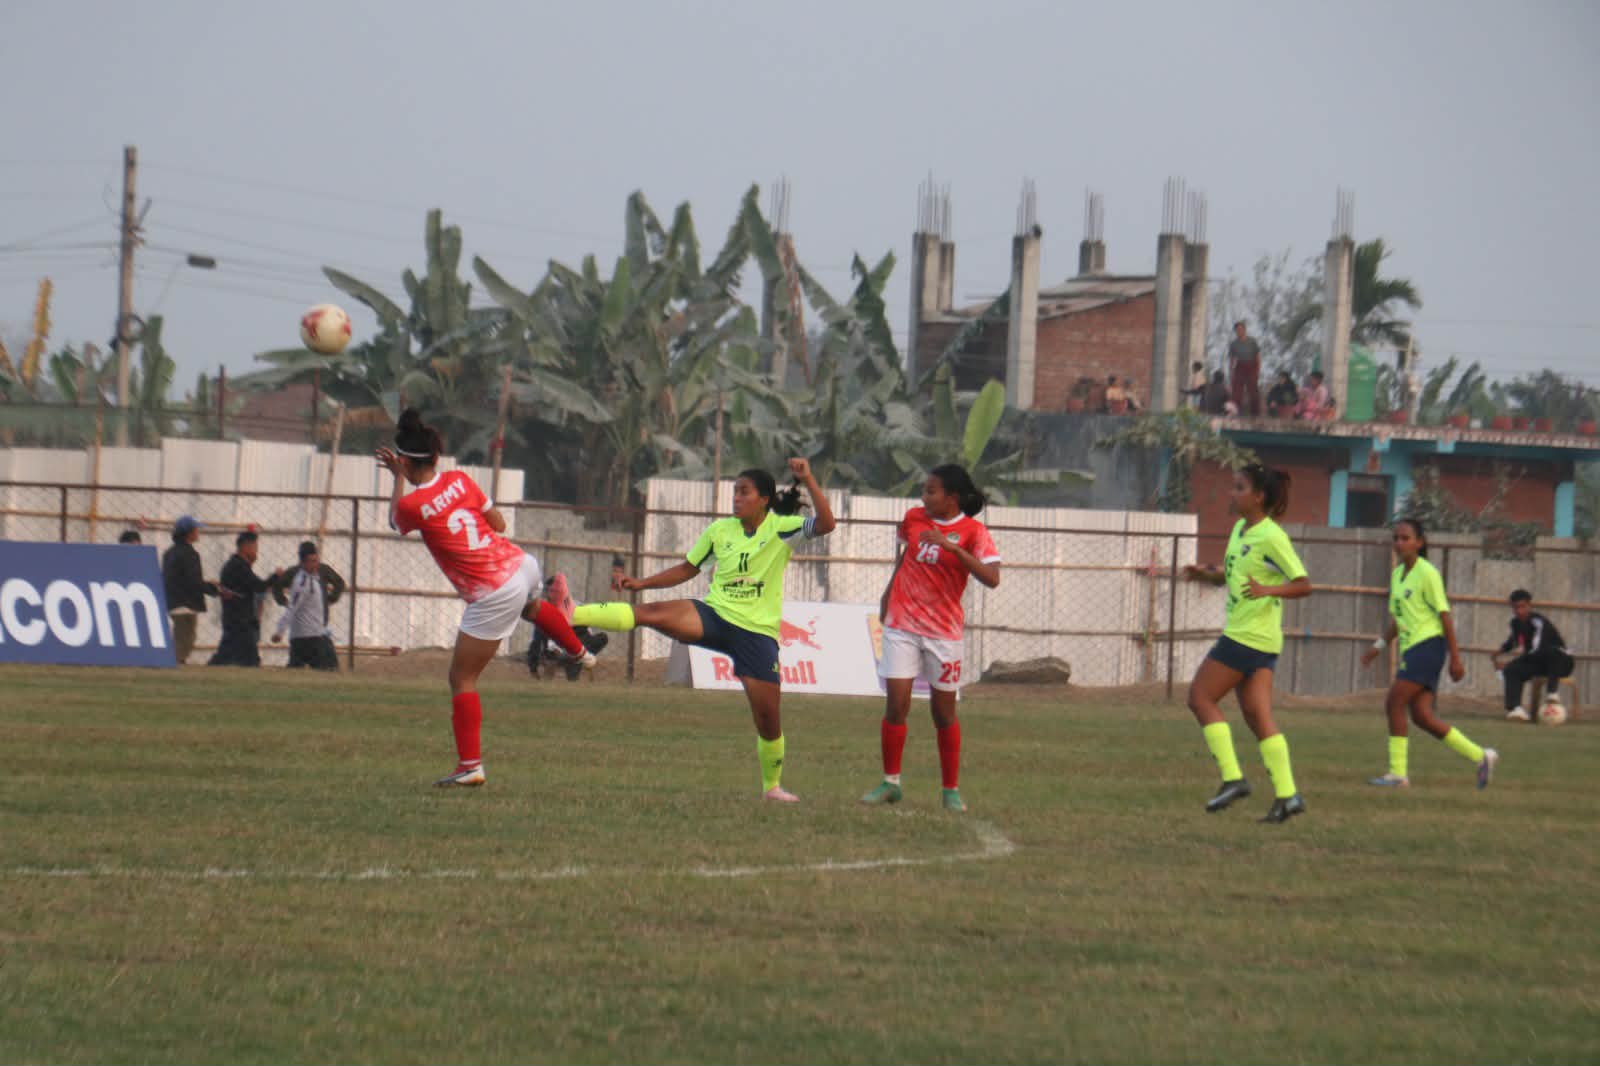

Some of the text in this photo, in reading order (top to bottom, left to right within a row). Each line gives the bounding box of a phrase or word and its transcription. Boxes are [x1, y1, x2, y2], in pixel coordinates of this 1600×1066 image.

[421, 478, 466, 519] ARMY
[447, 508, 492, 551] 2
[738, 552, 750, 573] 11
[0, 578, 166, 648] com
[779, 660, 817, 685] ull
[938, 660, 961, 684] 25
